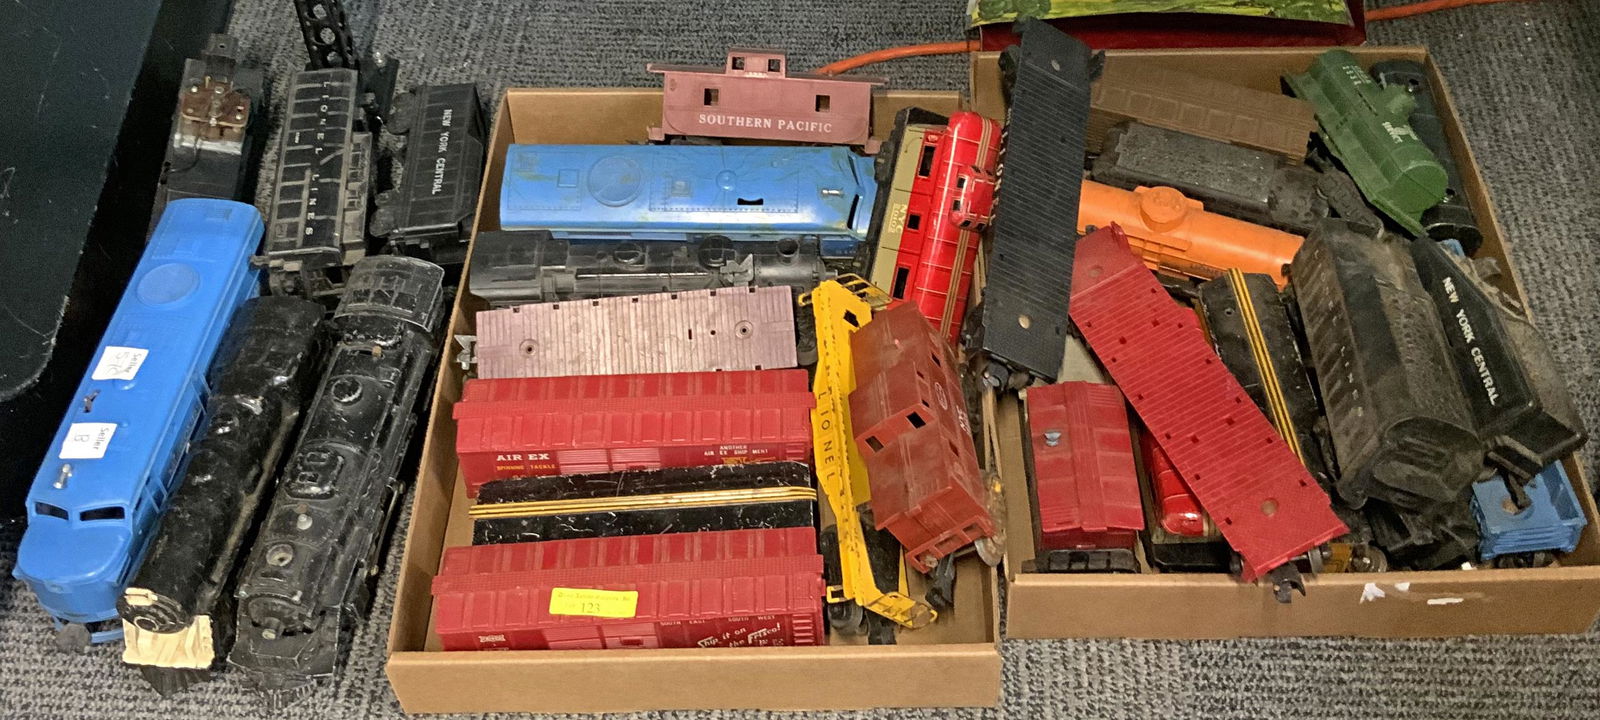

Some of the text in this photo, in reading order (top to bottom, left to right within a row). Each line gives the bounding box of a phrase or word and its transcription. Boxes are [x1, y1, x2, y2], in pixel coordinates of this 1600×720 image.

[699, 113, 832, 133] SOUTHERN PACIFIC
[305, 81, 330, 236] LIONEL LINES
[431, 109, 453, 195] NEW YORK CENTRAL
[1442, 276, 1500, 406] NEW YORK CENTRAL
[74, 434, 90, 443] B
[93, 427, 110, 450] Seller
[817, 391, 836, 480] LIONEL
[581, 602, 601, 614] 123
[722, 632, 731, 640] it
[735, 627, 747, 636] on
